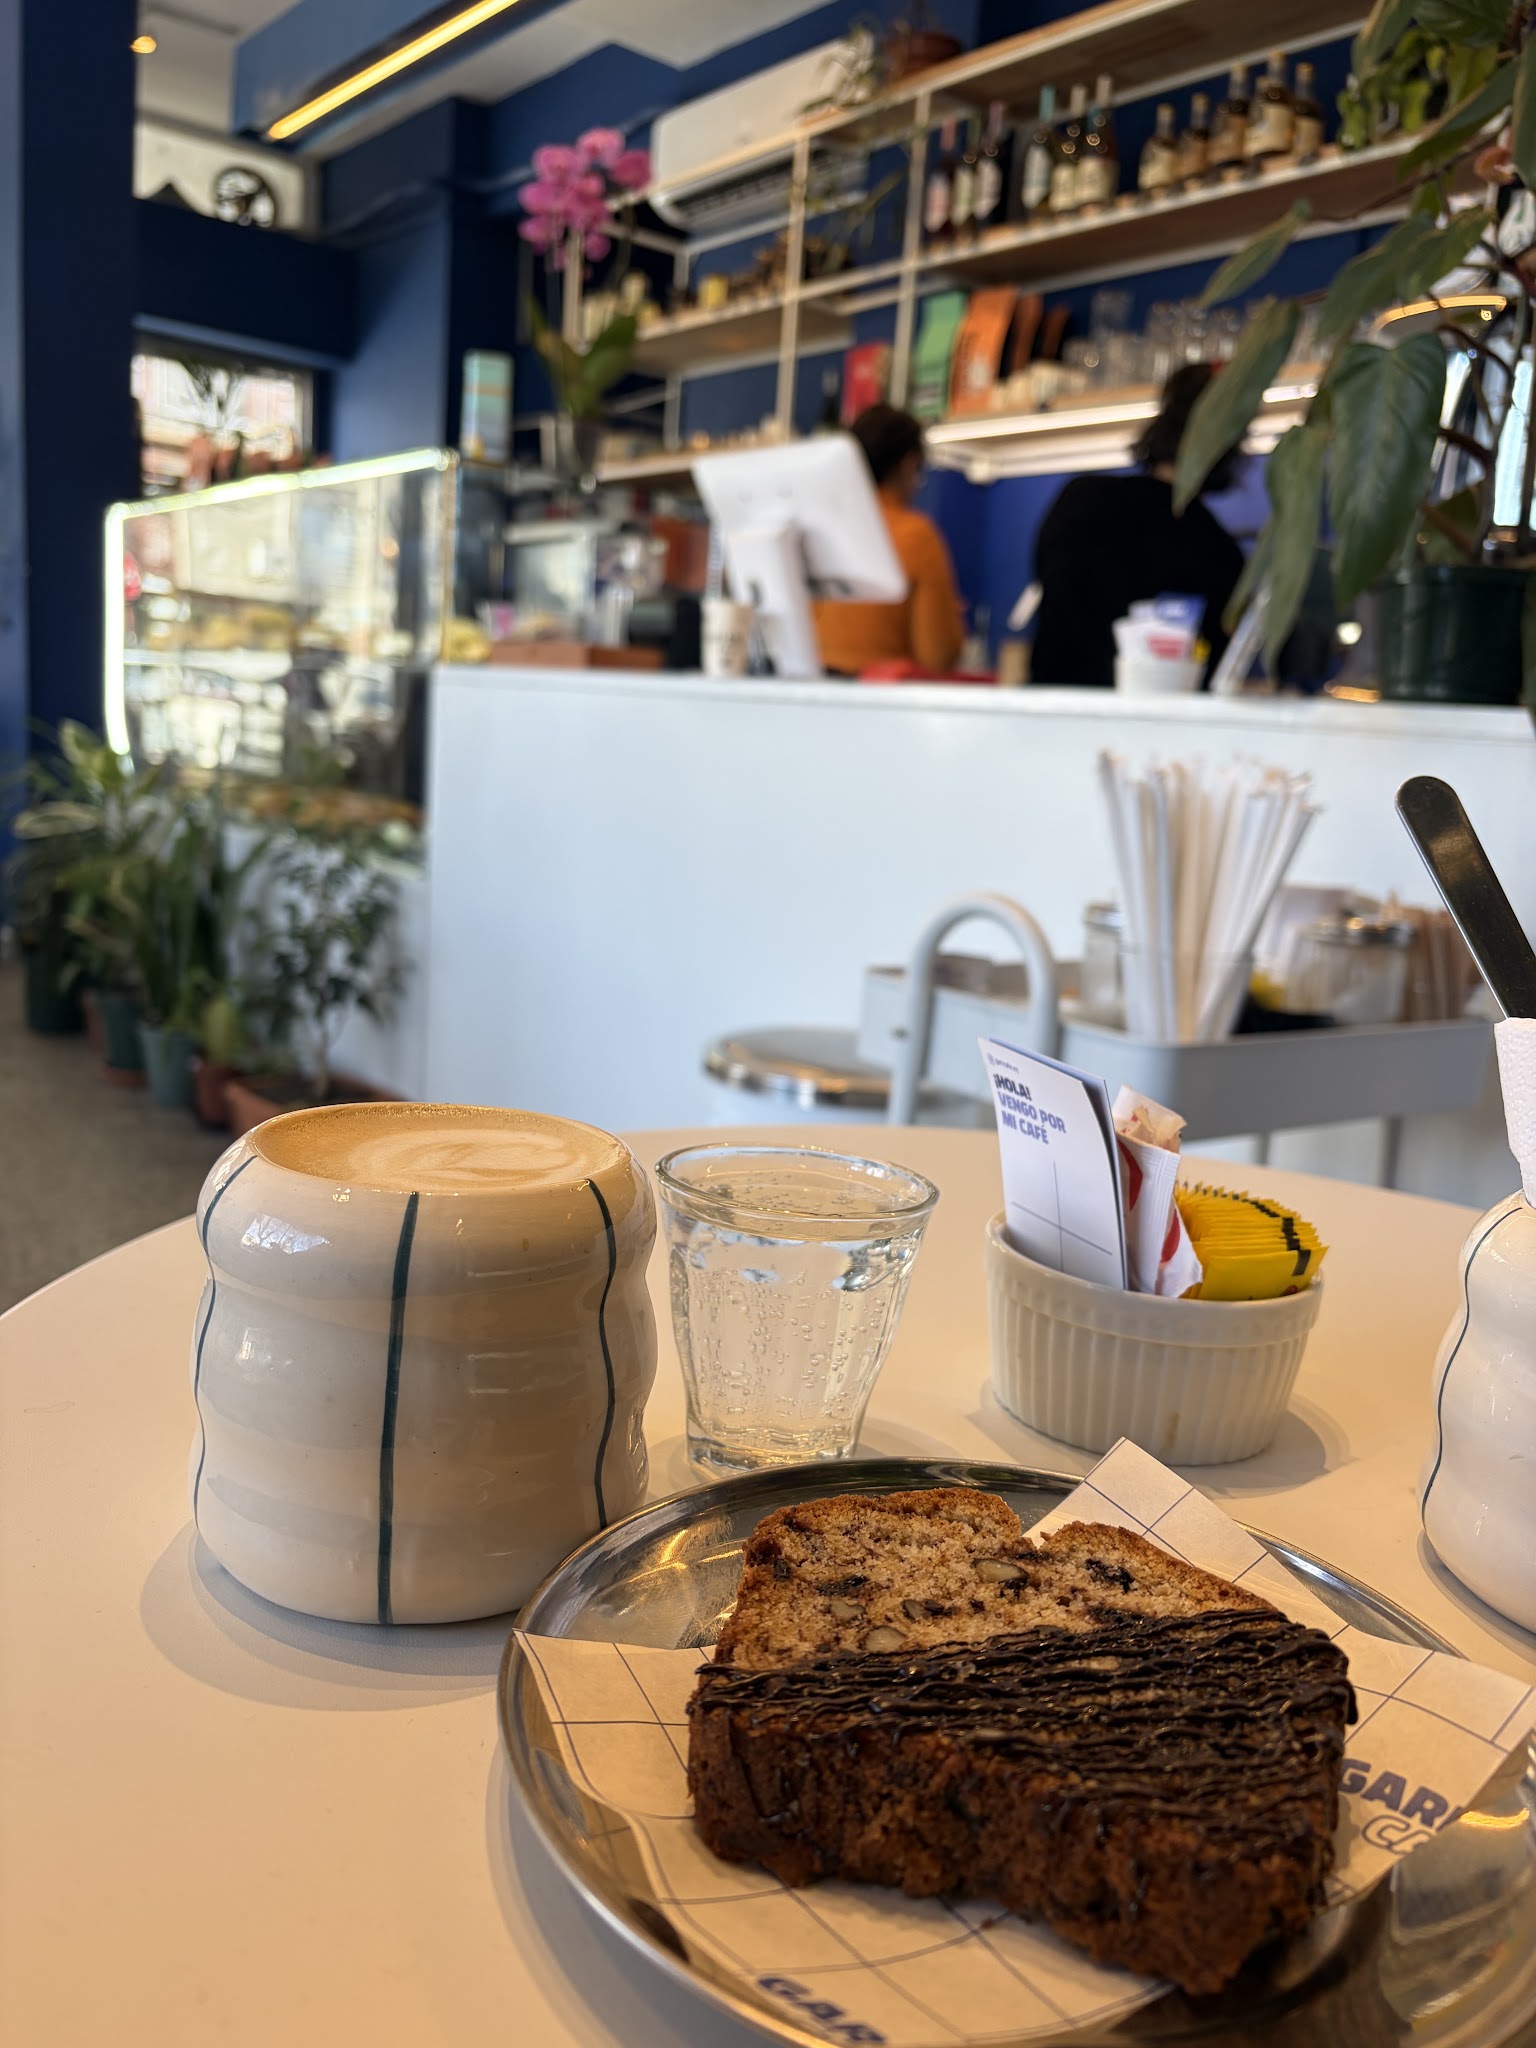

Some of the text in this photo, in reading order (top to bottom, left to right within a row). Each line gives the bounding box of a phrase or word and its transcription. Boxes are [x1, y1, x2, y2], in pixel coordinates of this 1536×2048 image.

[993, 1073, 1033, 1101] ¡HOLA!
[997, 1091, 1067, 1134] VENGO POR
[1001, 1110, 1049, 1145] MI CAFÉ
